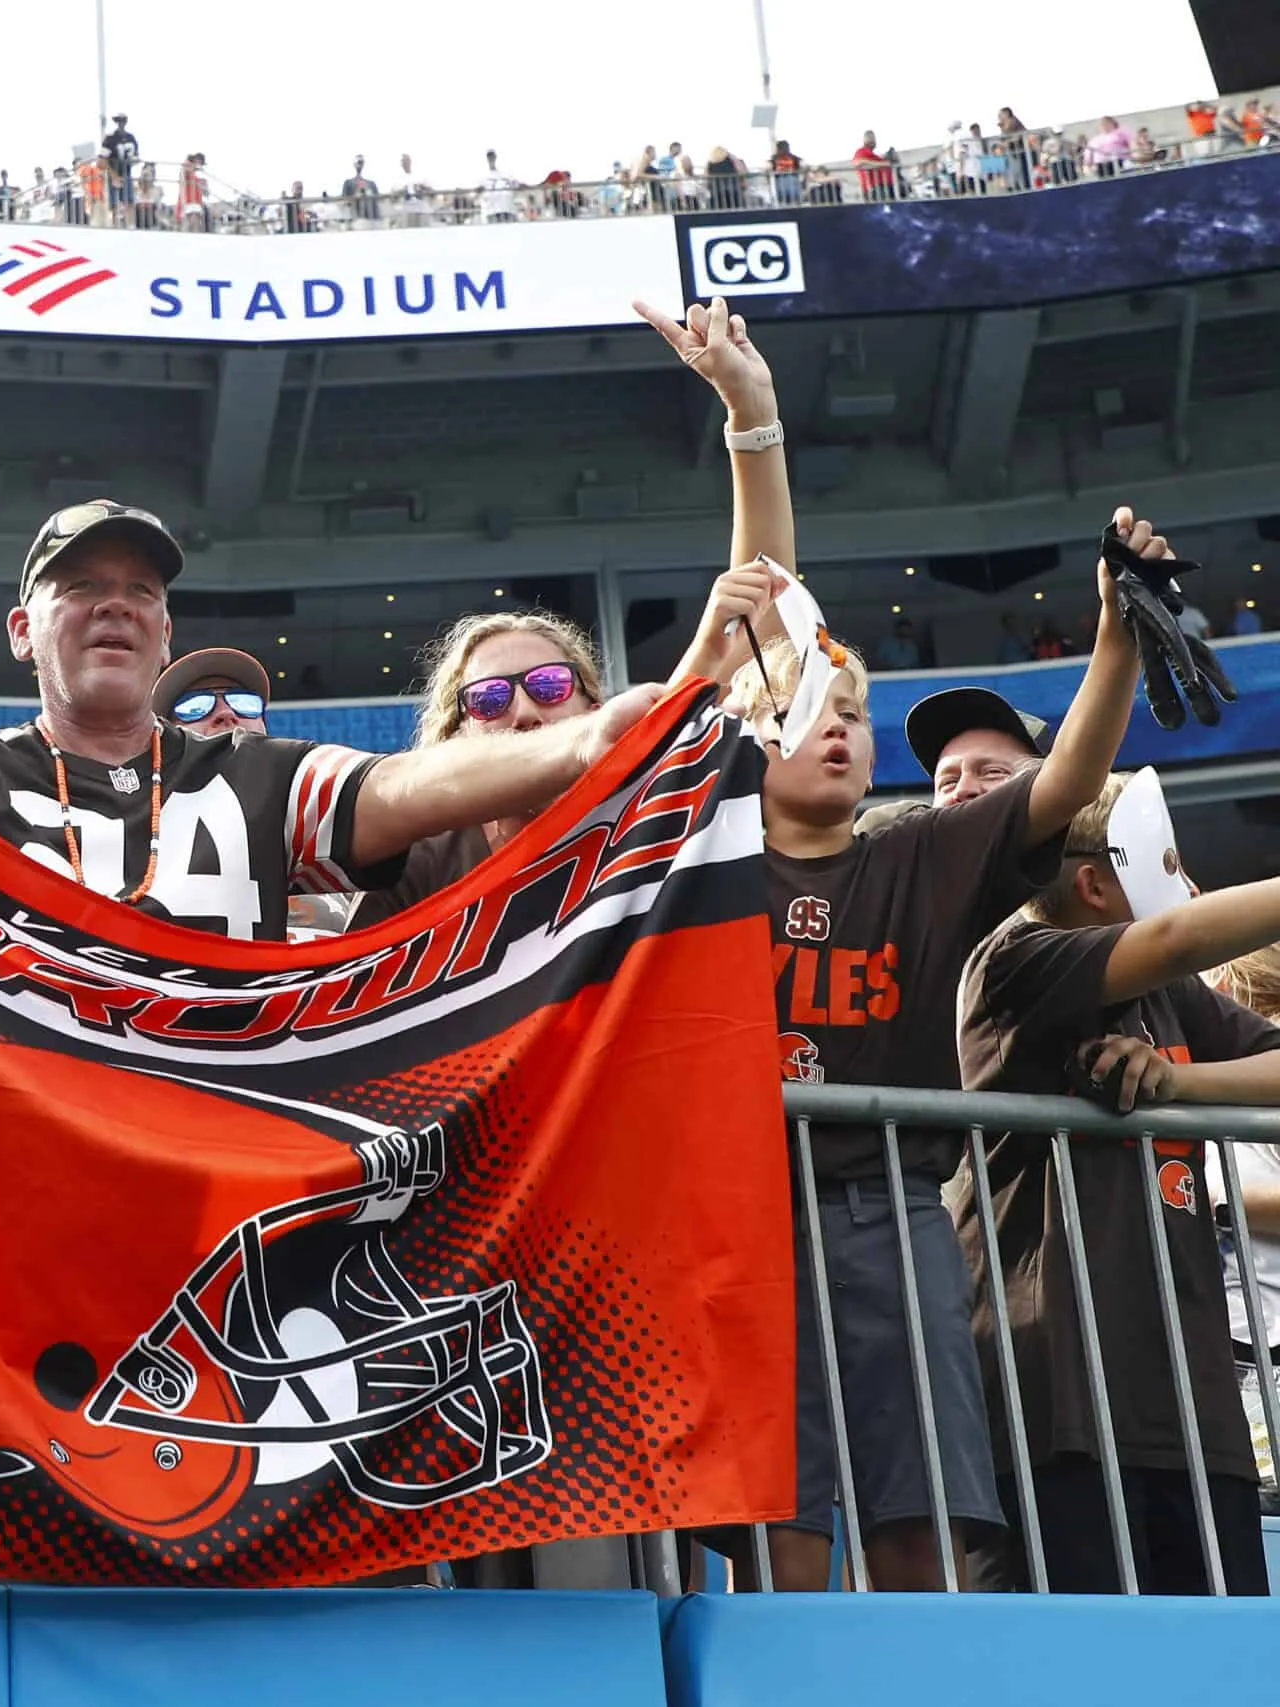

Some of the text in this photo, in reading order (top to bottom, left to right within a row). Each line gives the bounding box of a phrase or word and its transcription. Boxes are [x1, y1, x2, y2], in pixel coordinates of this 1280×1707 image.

[708, 238, 786, 283] CC
[149, 270, 507, 321] STADIUM
[785, 895, 831, 942] 95
